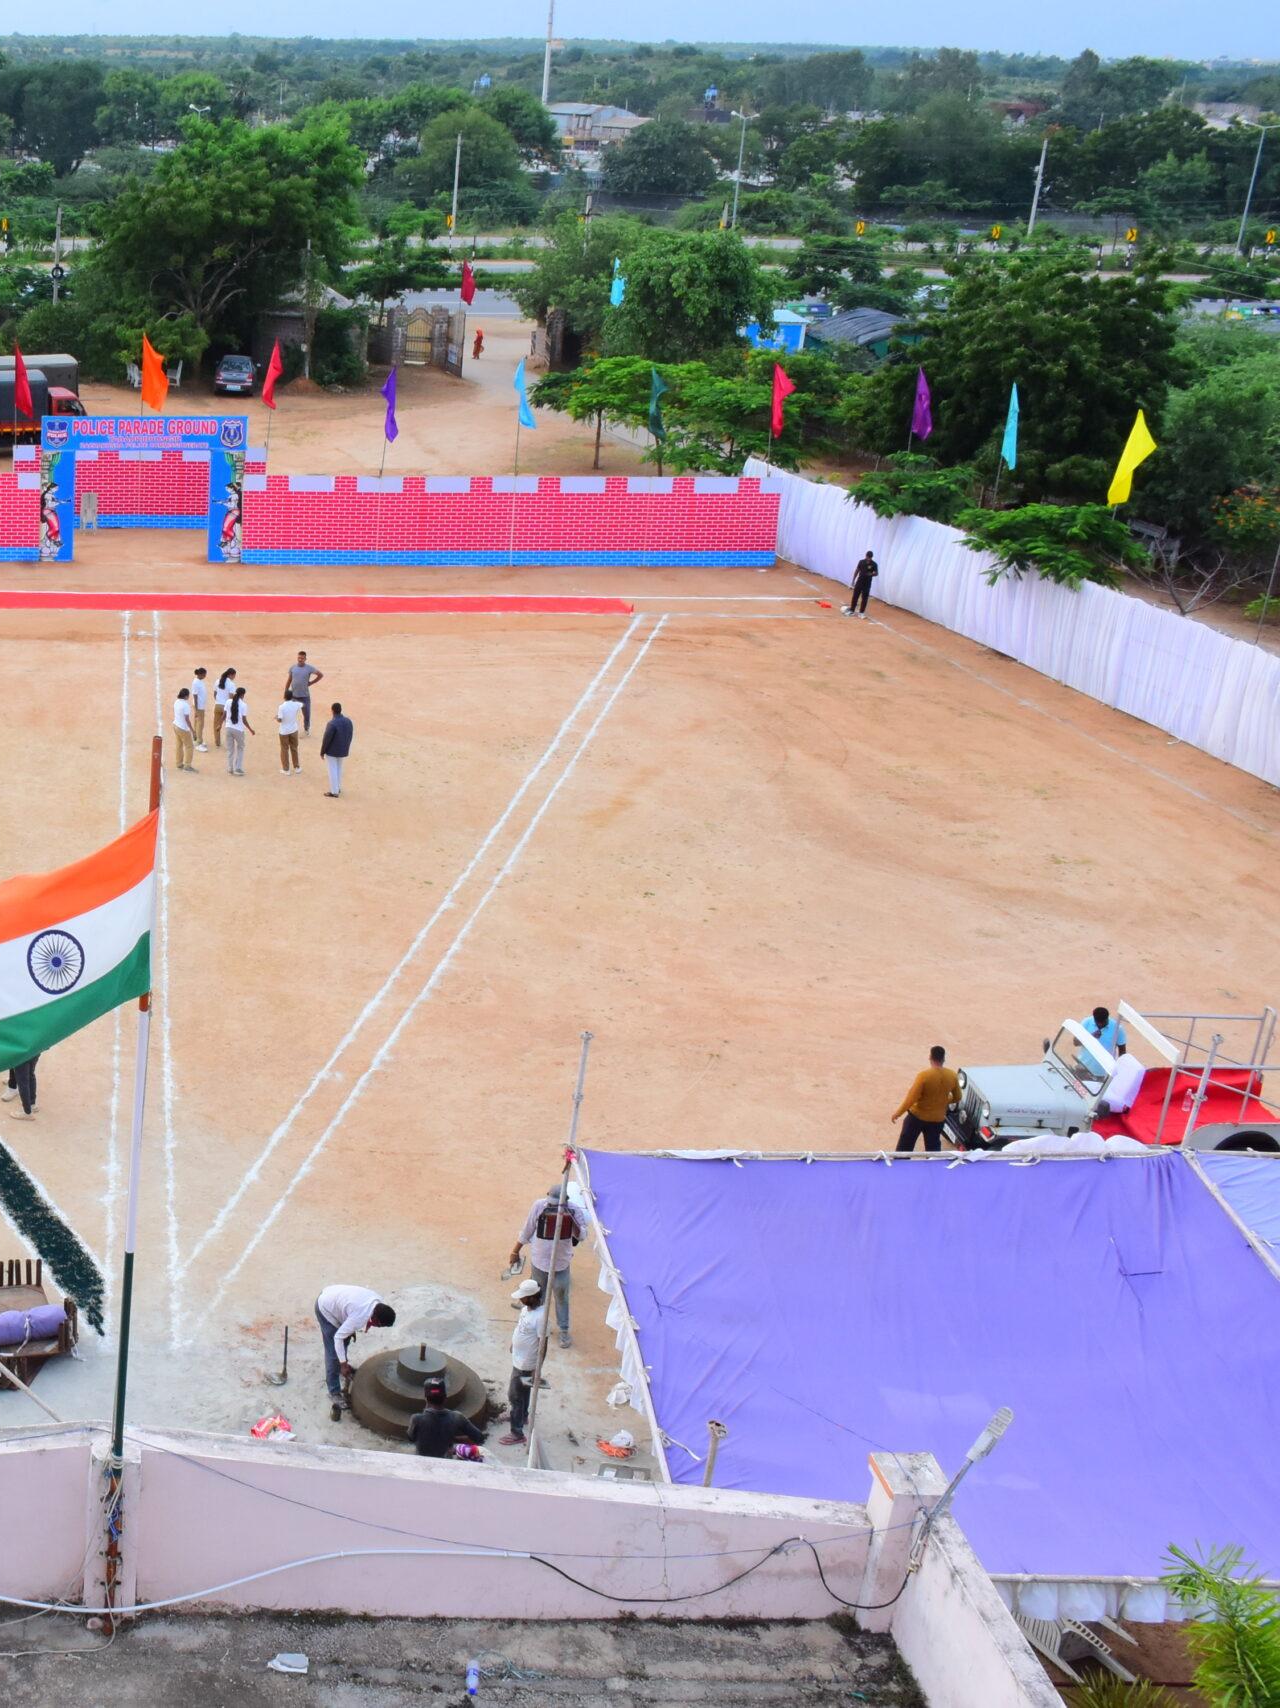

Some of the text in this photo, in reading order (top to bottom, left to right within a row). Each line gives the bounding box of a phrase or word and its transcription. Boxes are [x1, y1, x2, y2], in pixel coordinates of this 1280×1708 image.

[72, 419, 218, 435] POLICE PARADE GROUND
